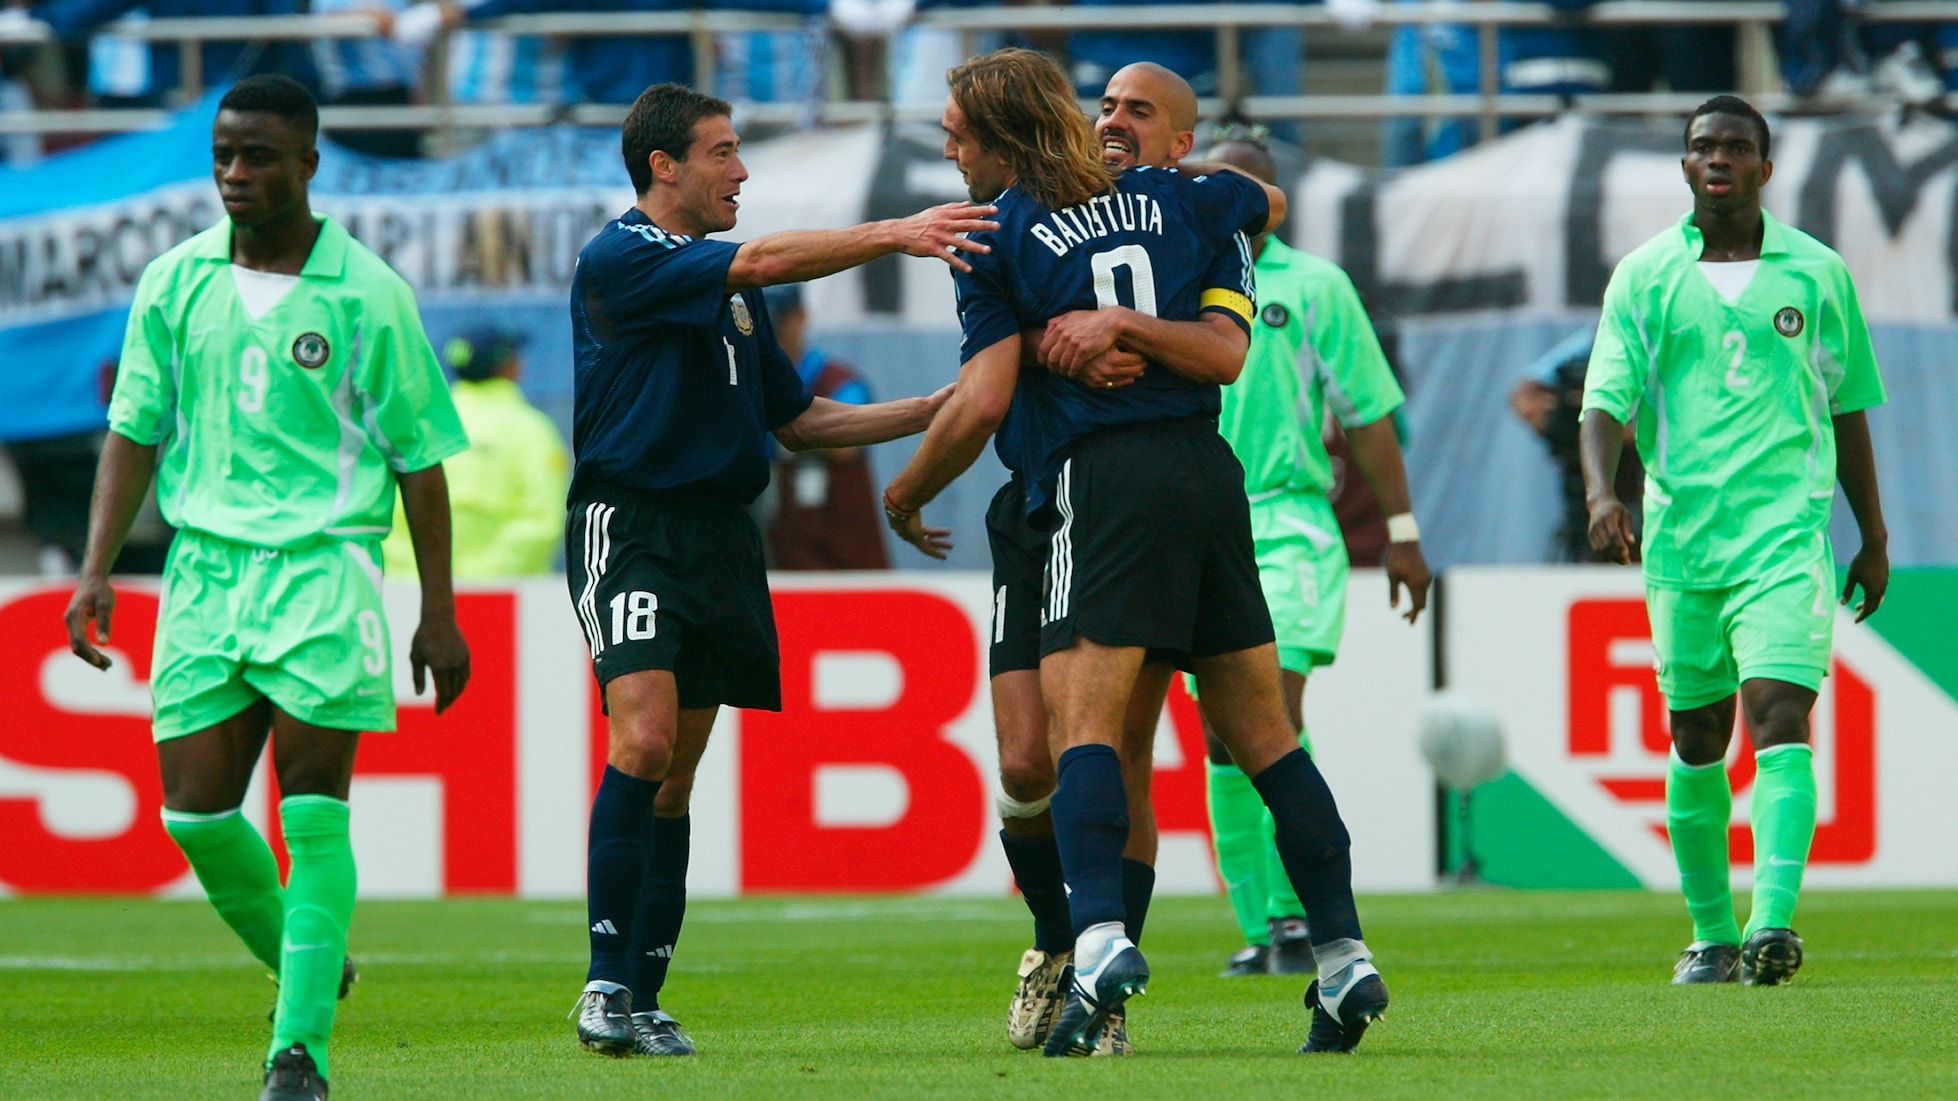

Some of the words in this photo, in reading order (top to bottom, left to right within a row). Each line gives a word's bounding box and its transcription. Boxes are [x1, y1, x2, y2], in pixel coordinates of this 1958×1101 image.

[1030, 193, 1163, 257] BATISTUTA
[238, 345, 268, 413] 9
[1722, 330, 1749, 388] 2
[357, 609, 387, 676] 9
[609, 590, 658, 646] 18
